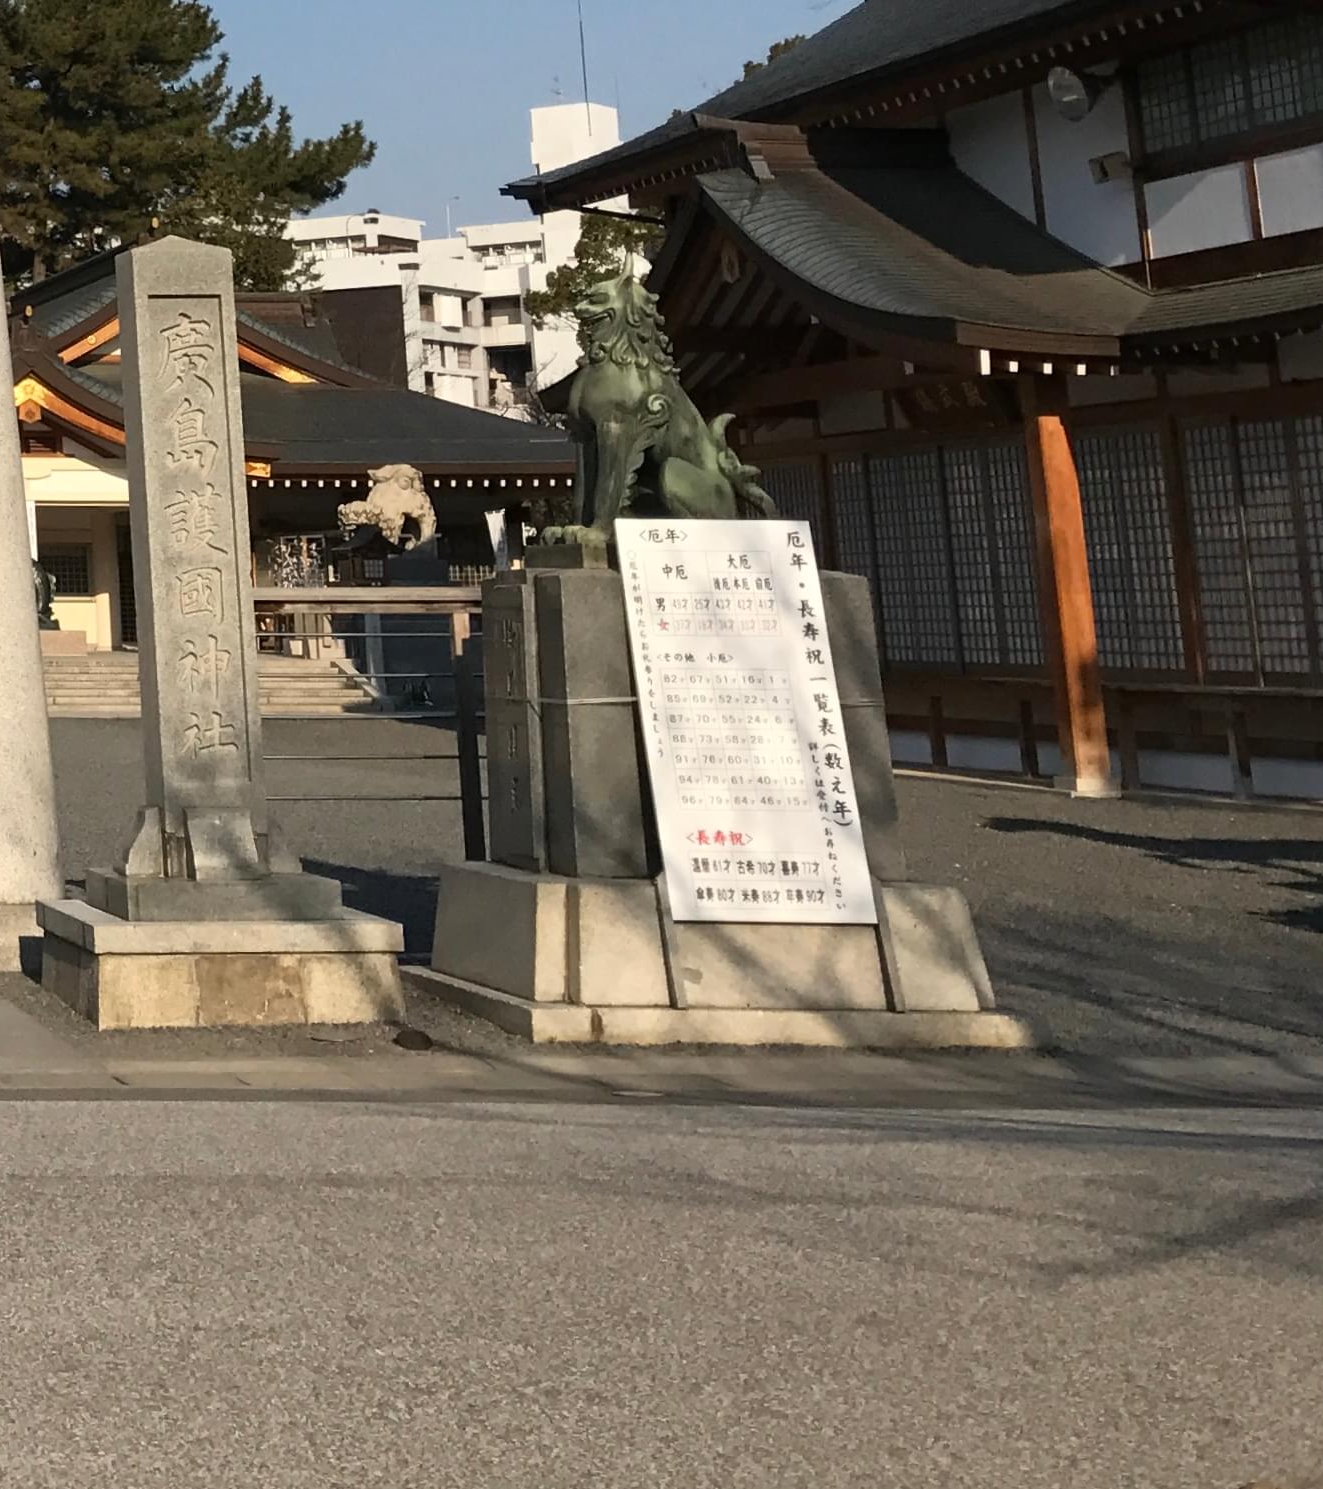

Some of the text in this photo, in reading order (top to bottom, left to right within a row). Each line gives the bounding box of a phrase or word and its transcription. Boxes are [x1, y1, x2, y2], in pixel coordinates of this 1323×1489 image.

[154, 310, 240, 761] 廣島護國神社
[727, 554, 752, 569] 大厄
[662, 563, 688, 580] 中厄
[655, 597, 665, 612] 男
[657, 618, 670, 631] 女
